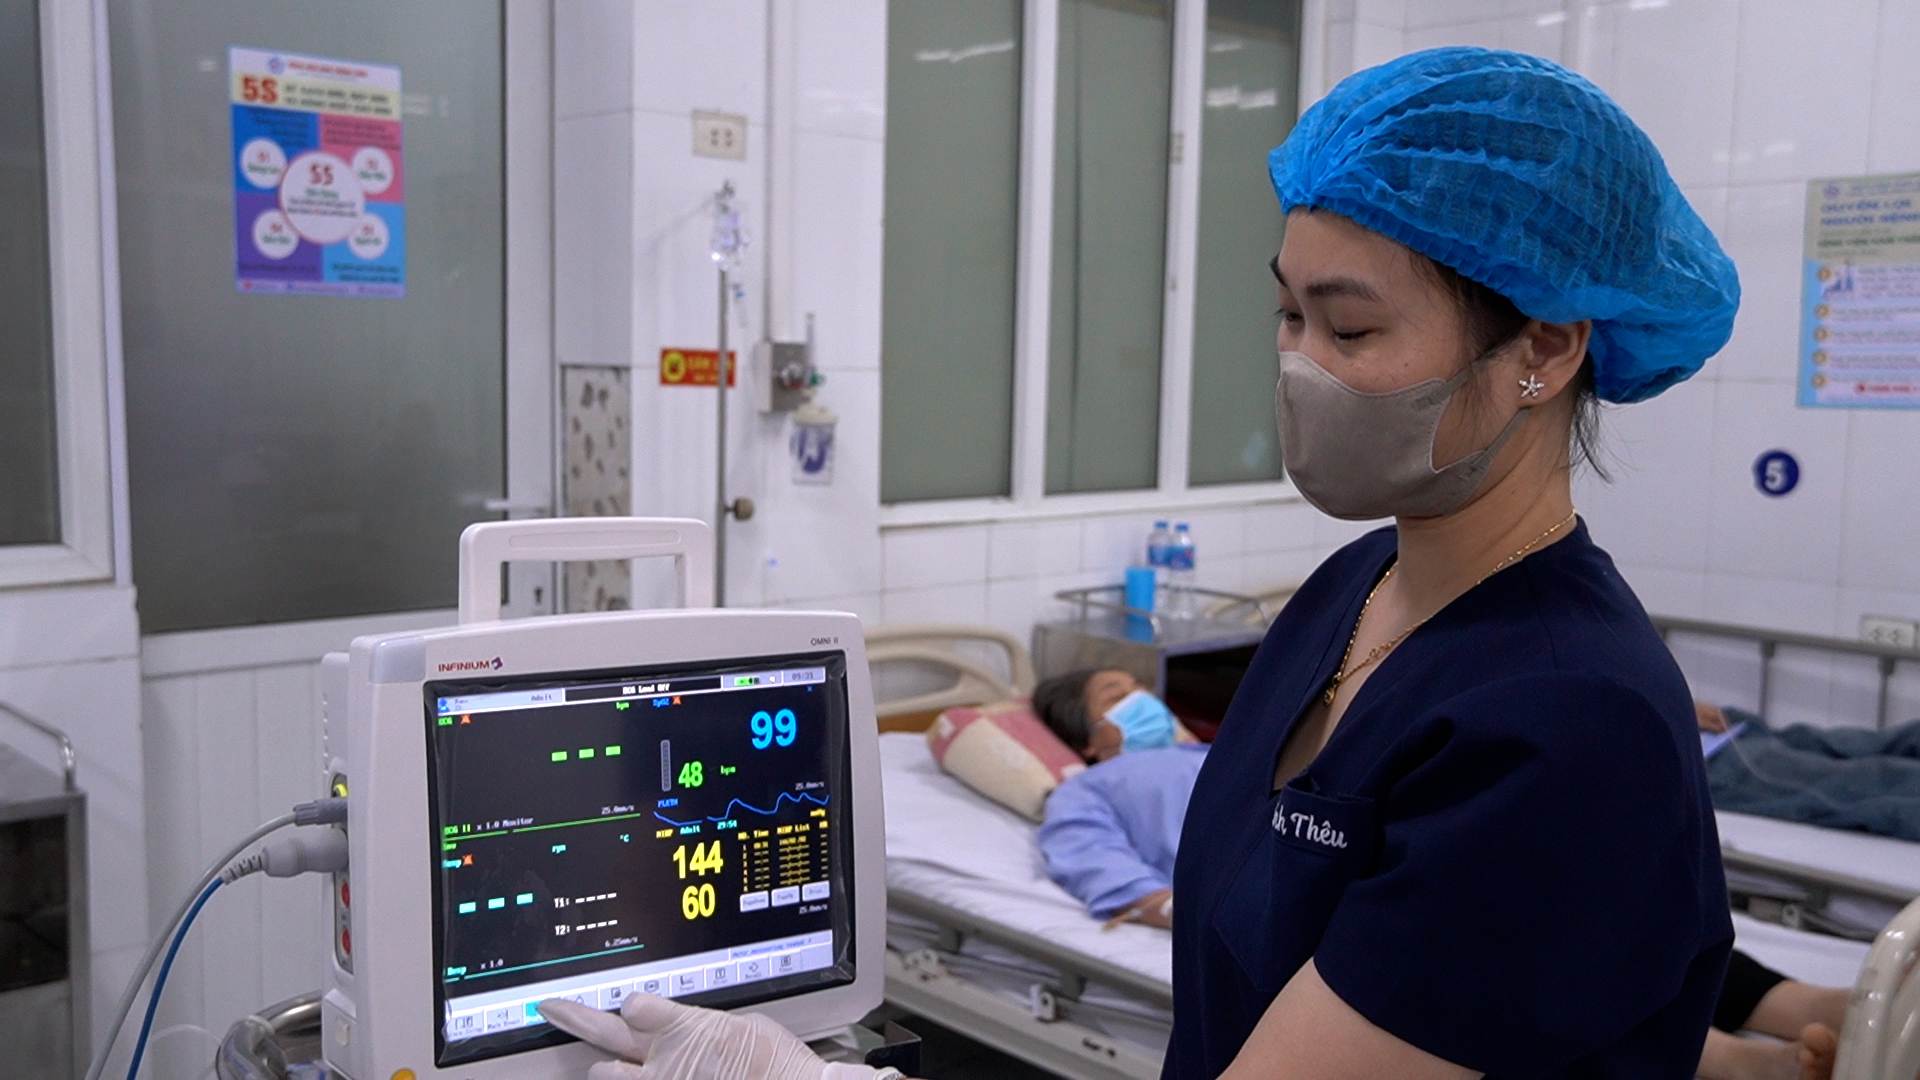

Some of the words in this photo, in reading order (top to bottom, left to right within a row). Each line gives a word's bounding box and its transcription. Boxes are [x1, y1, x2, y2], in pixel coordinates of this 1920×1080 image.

[241, 74, 279, 104] 5S
[1764, 459, 1787, 490] 5
[810, 637, 831, 646] OMNI
[438, 660, 490, 672] INFINIUM
[751, 708, 797, 750] 99
[678, 761, 703, 788] 48
[1290, 812, 1348, 849] Thêu
[673, 840, 724, 879] 144
[682, 883, 716, 920] 60
